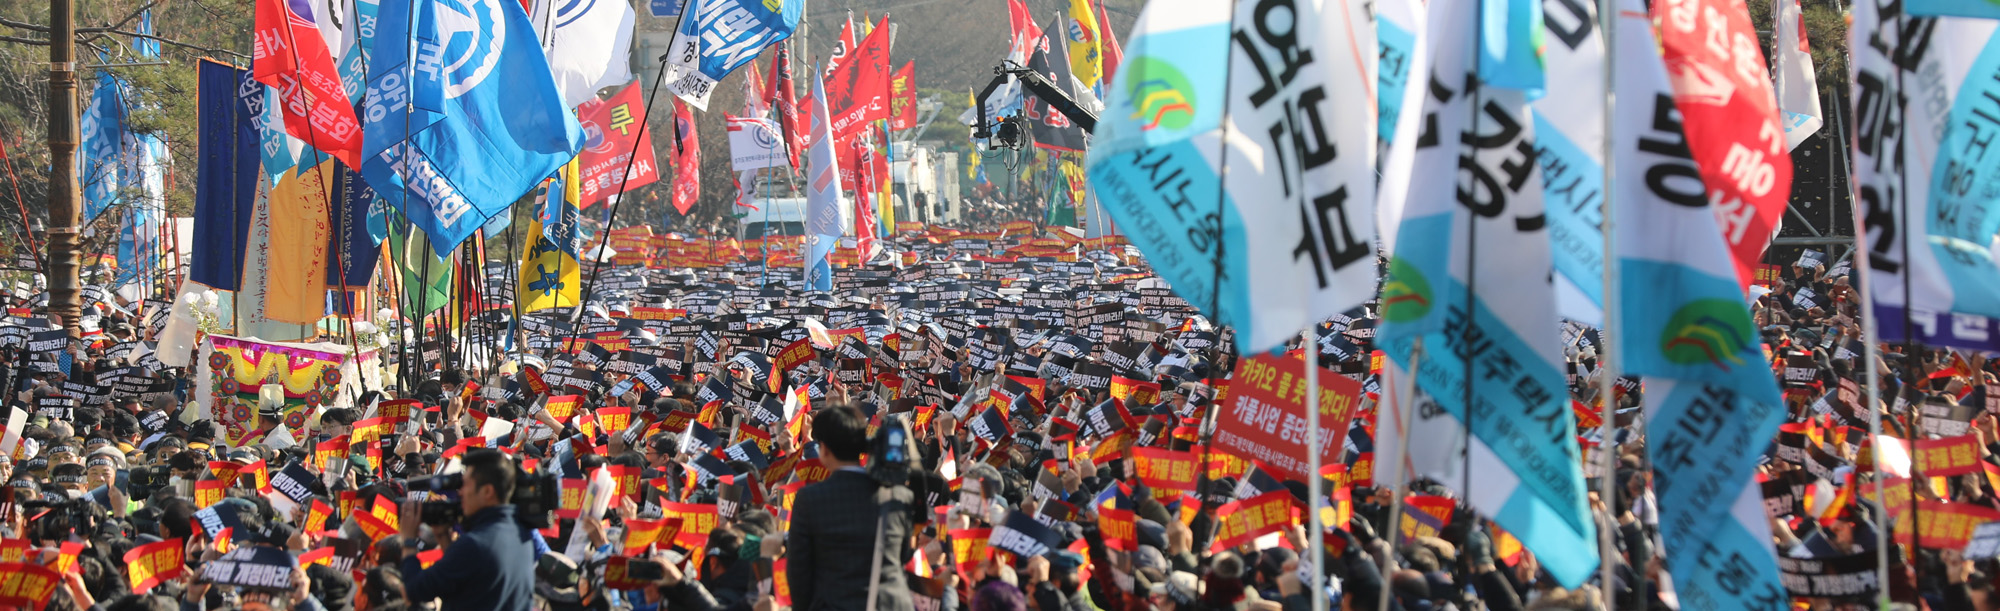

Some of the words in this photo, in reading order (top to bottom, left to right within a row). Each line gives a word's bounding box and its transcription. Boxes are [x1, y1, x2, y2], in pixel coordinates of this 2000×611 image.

[1093, 312, 1123, 324] 개정하라!!
[1103, 350, 1135, 370] 정하라!!
[1071, 372, 1110, 389] 정하라!!
[1241, 358, 1277, 391] 카카오
[1276, 371, 1293, 399] 콜
[385, 404, 400, 418] 카풀
[1233, 394, 1282, 434] 카풀사업
[1171, 460, 1198, 483] 퇴출!
